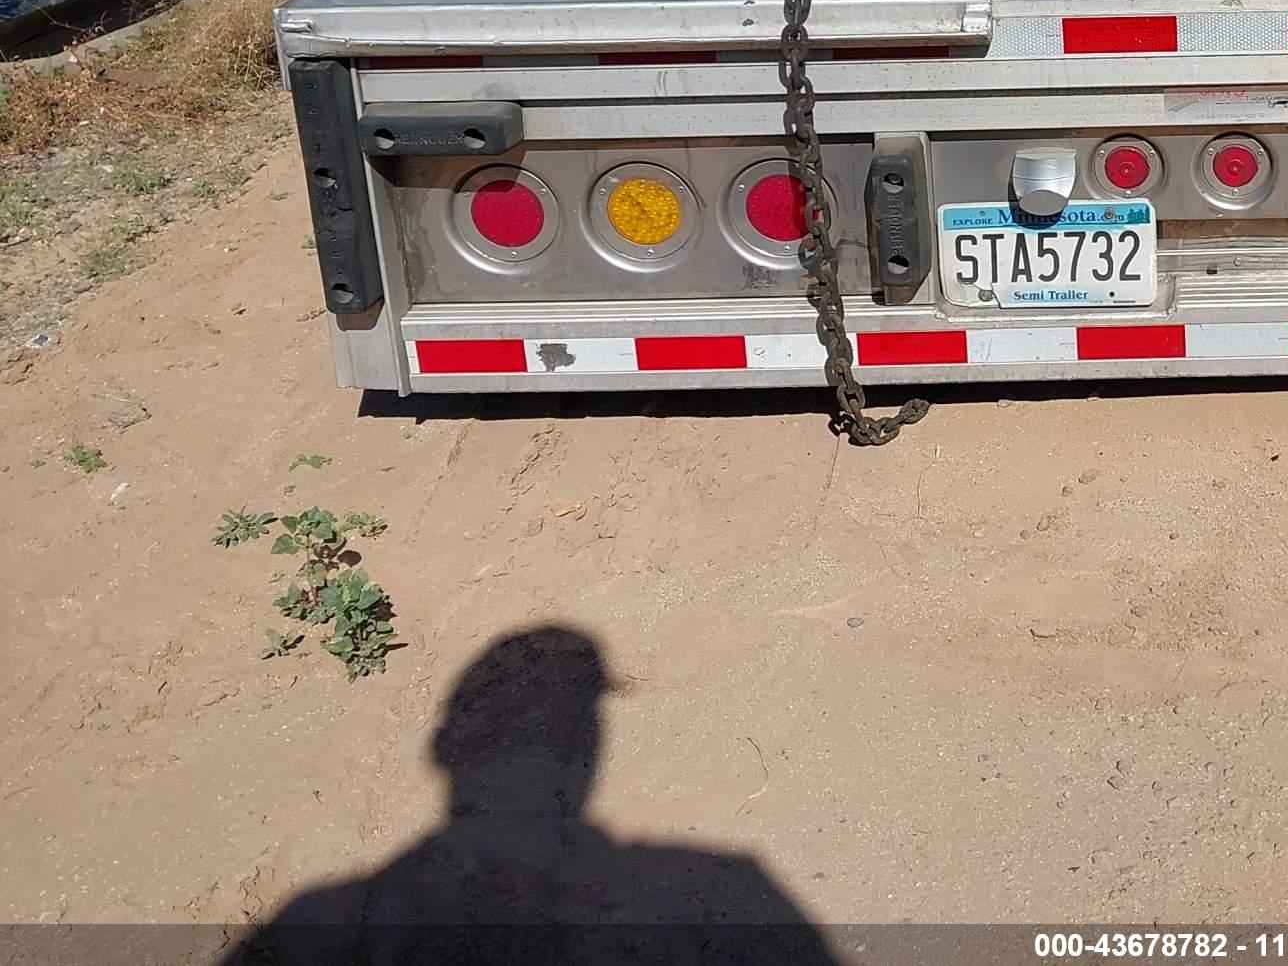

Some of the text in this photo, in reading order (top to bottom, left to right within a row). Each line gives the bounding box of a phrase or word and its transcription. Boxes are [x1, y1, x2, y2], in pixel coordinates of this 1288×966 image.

[952, 217, 993, 226] EXPLORE
[955, 230, 1141, 283] STA5732
[1013, 290, 1088, 301] Semi Trailer
